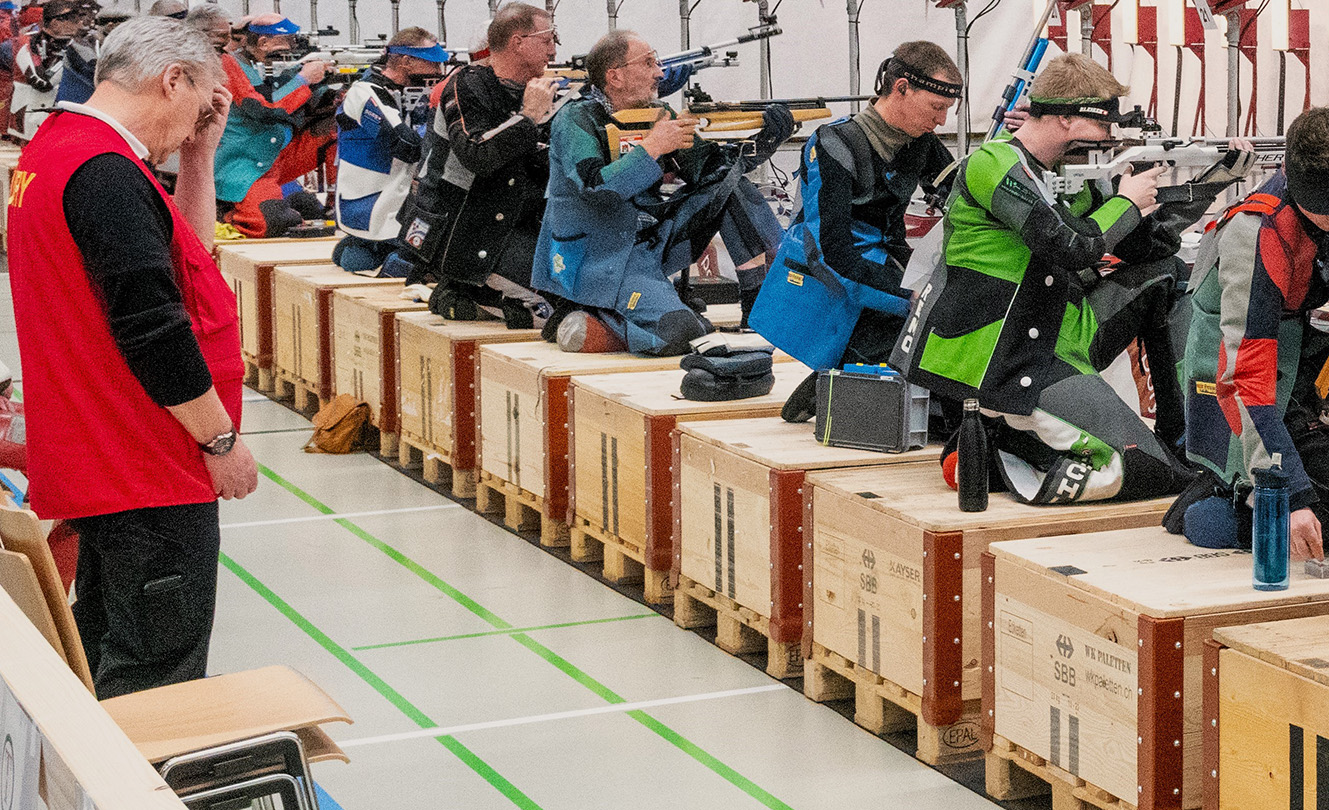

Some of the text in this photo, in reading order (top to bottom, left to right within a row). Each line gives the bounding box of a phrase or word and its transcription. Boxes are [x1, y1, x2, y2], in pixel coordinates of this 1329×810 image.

[889, 560, 921, 582] KAYSER
[860, 572, 878, 594] SBB
[1085, 645, 1131, 674] WK PALETTEN
[1054, 660, 1077, 687] SBB
[949, 727, 977, 744] EPAL
